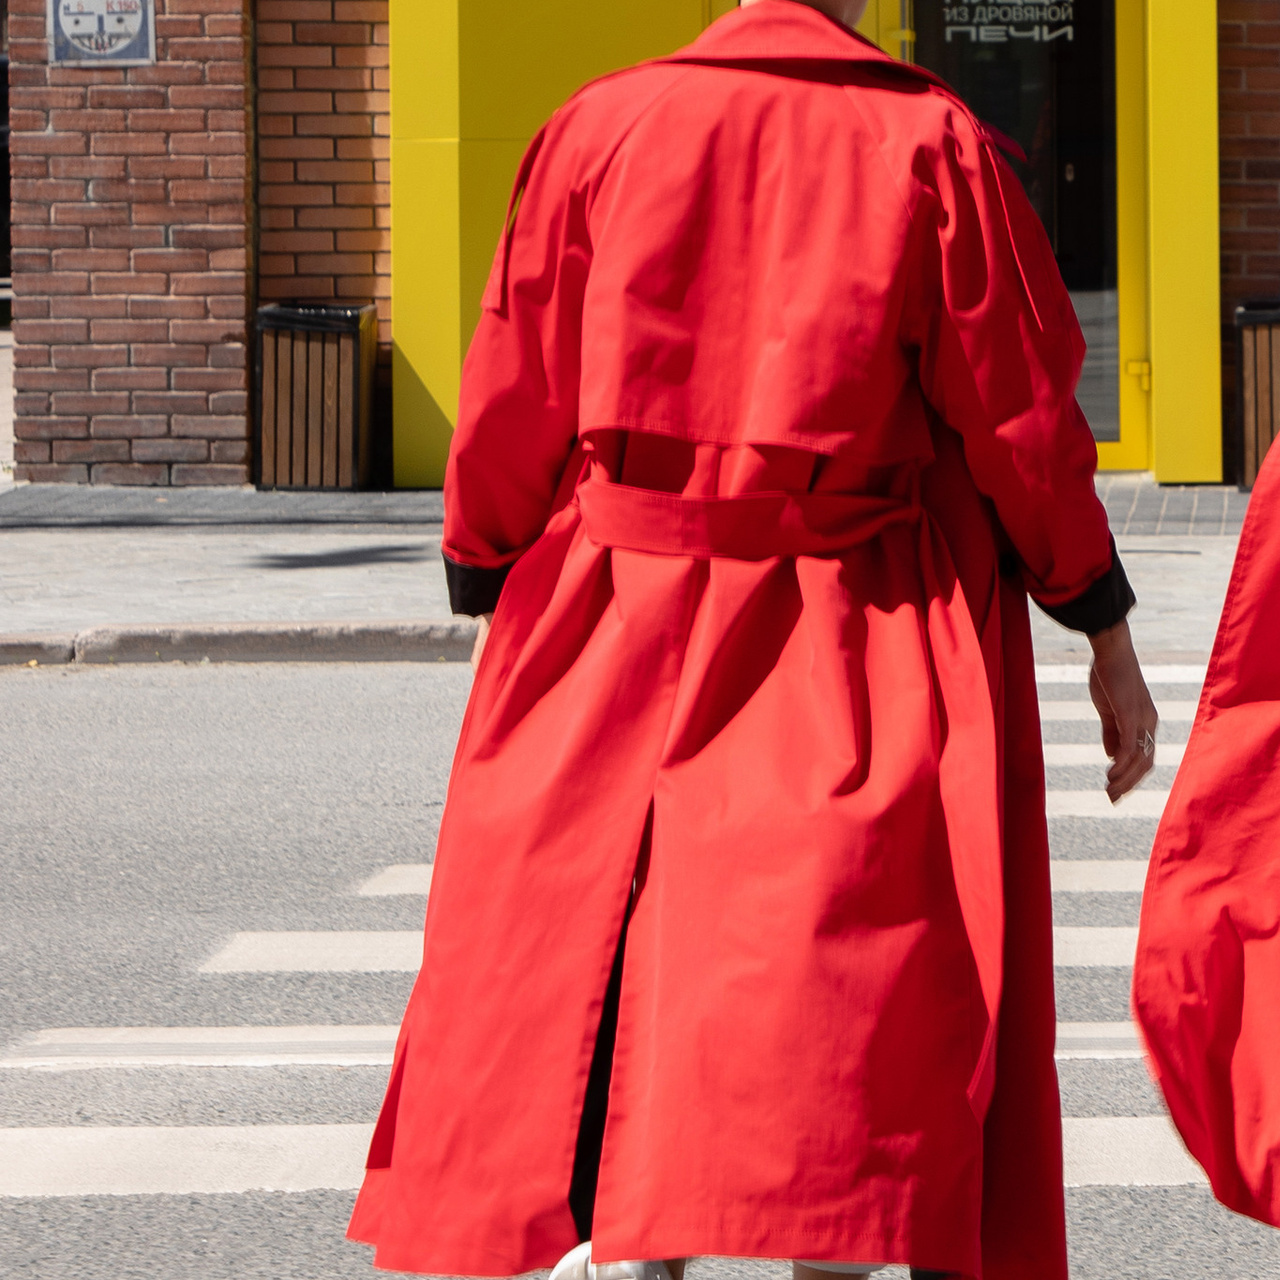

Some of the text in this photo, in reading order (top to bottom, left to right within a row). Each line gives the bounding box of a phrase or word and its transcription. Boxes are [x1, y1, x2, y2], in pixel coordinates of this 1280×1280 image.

[943, 2, 1073, 23] ИЗ ДРОВЯНОЙ
[945, 25, 1074, 43] ПЕЧИ
